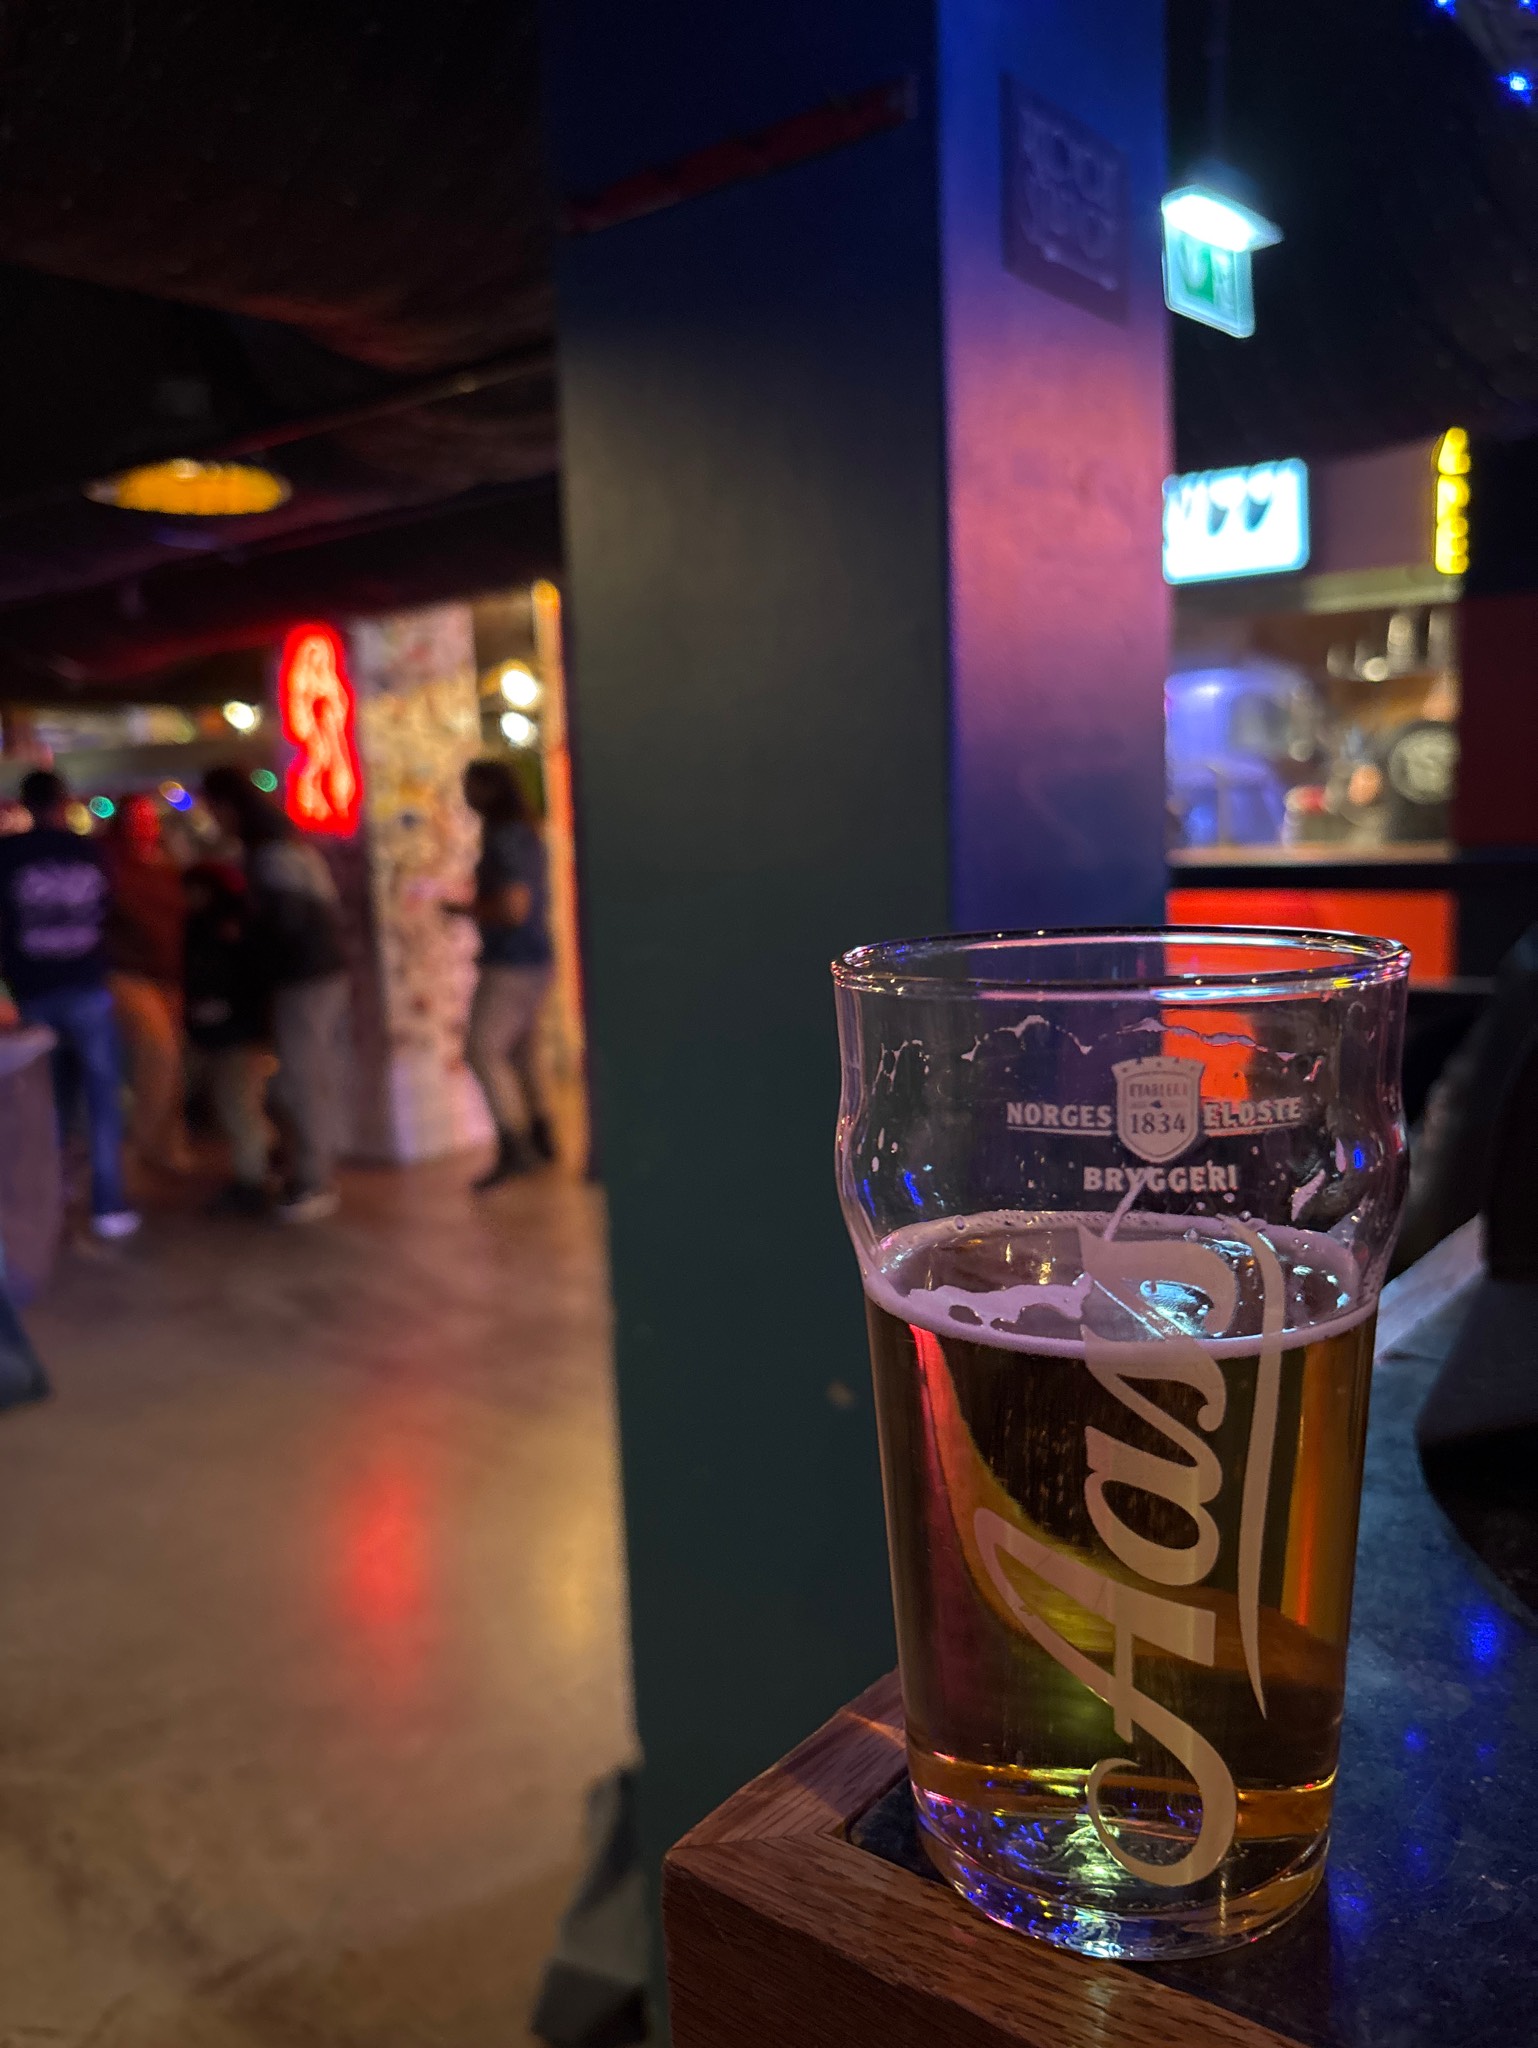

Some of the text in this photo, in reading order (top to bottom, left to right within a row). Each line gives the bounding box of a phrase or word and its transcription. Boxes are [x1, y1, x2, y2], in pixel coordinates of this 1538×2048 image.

[1006, 1096, 1301, 1129] NORGES ELDSTE
[1131, 1112, 1185, 1135] 1834
[1083, 1164, 1238, 1192] BRYGGERI
